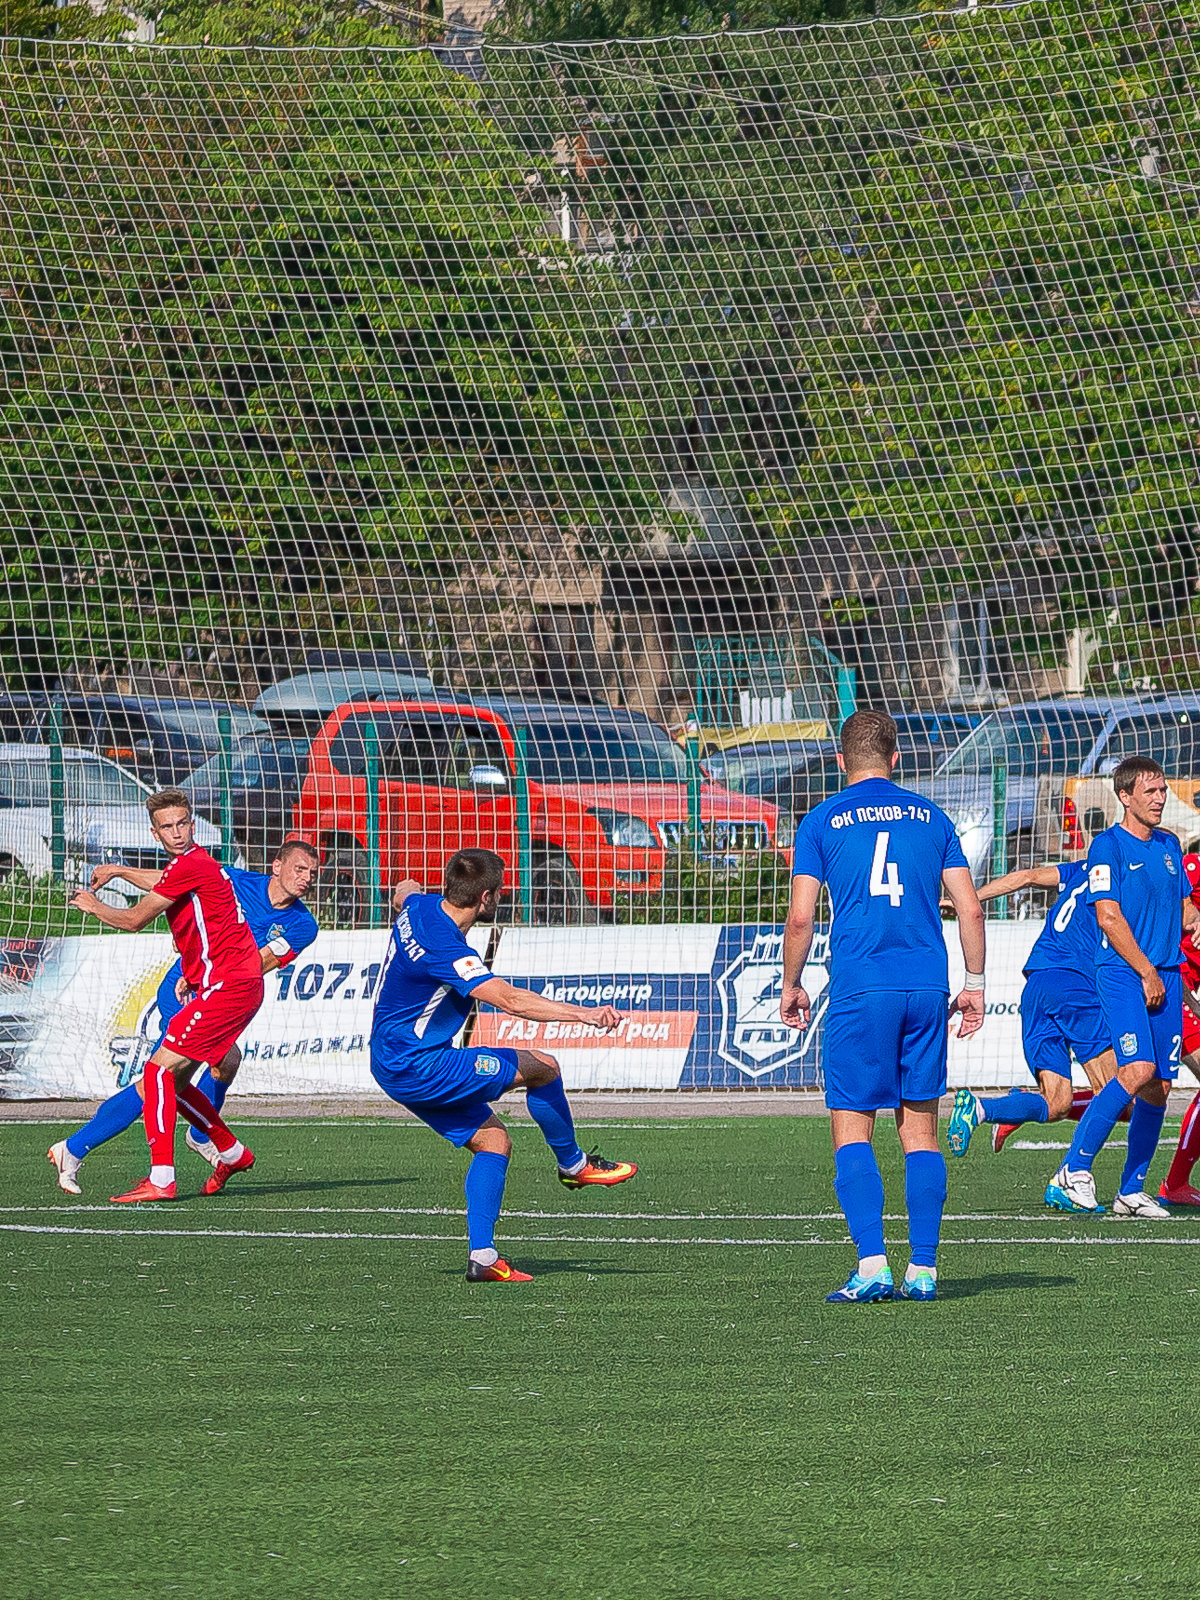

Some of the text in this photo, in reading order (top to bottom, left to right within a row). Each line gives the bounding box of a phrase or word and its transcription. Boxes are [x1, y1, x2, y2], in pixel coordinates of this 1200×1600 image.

[831, 806, 931, 829] ФК ПСКОВ-747
[869, 832, 904, 907] 4
[276, 963, 381, 1001] 107.1
[540, 982, 653, 1004] Автоцентр
[497, 1020, 540, 1041] ГАЗ
[243, 1034, 370, 1062] Наслажд
